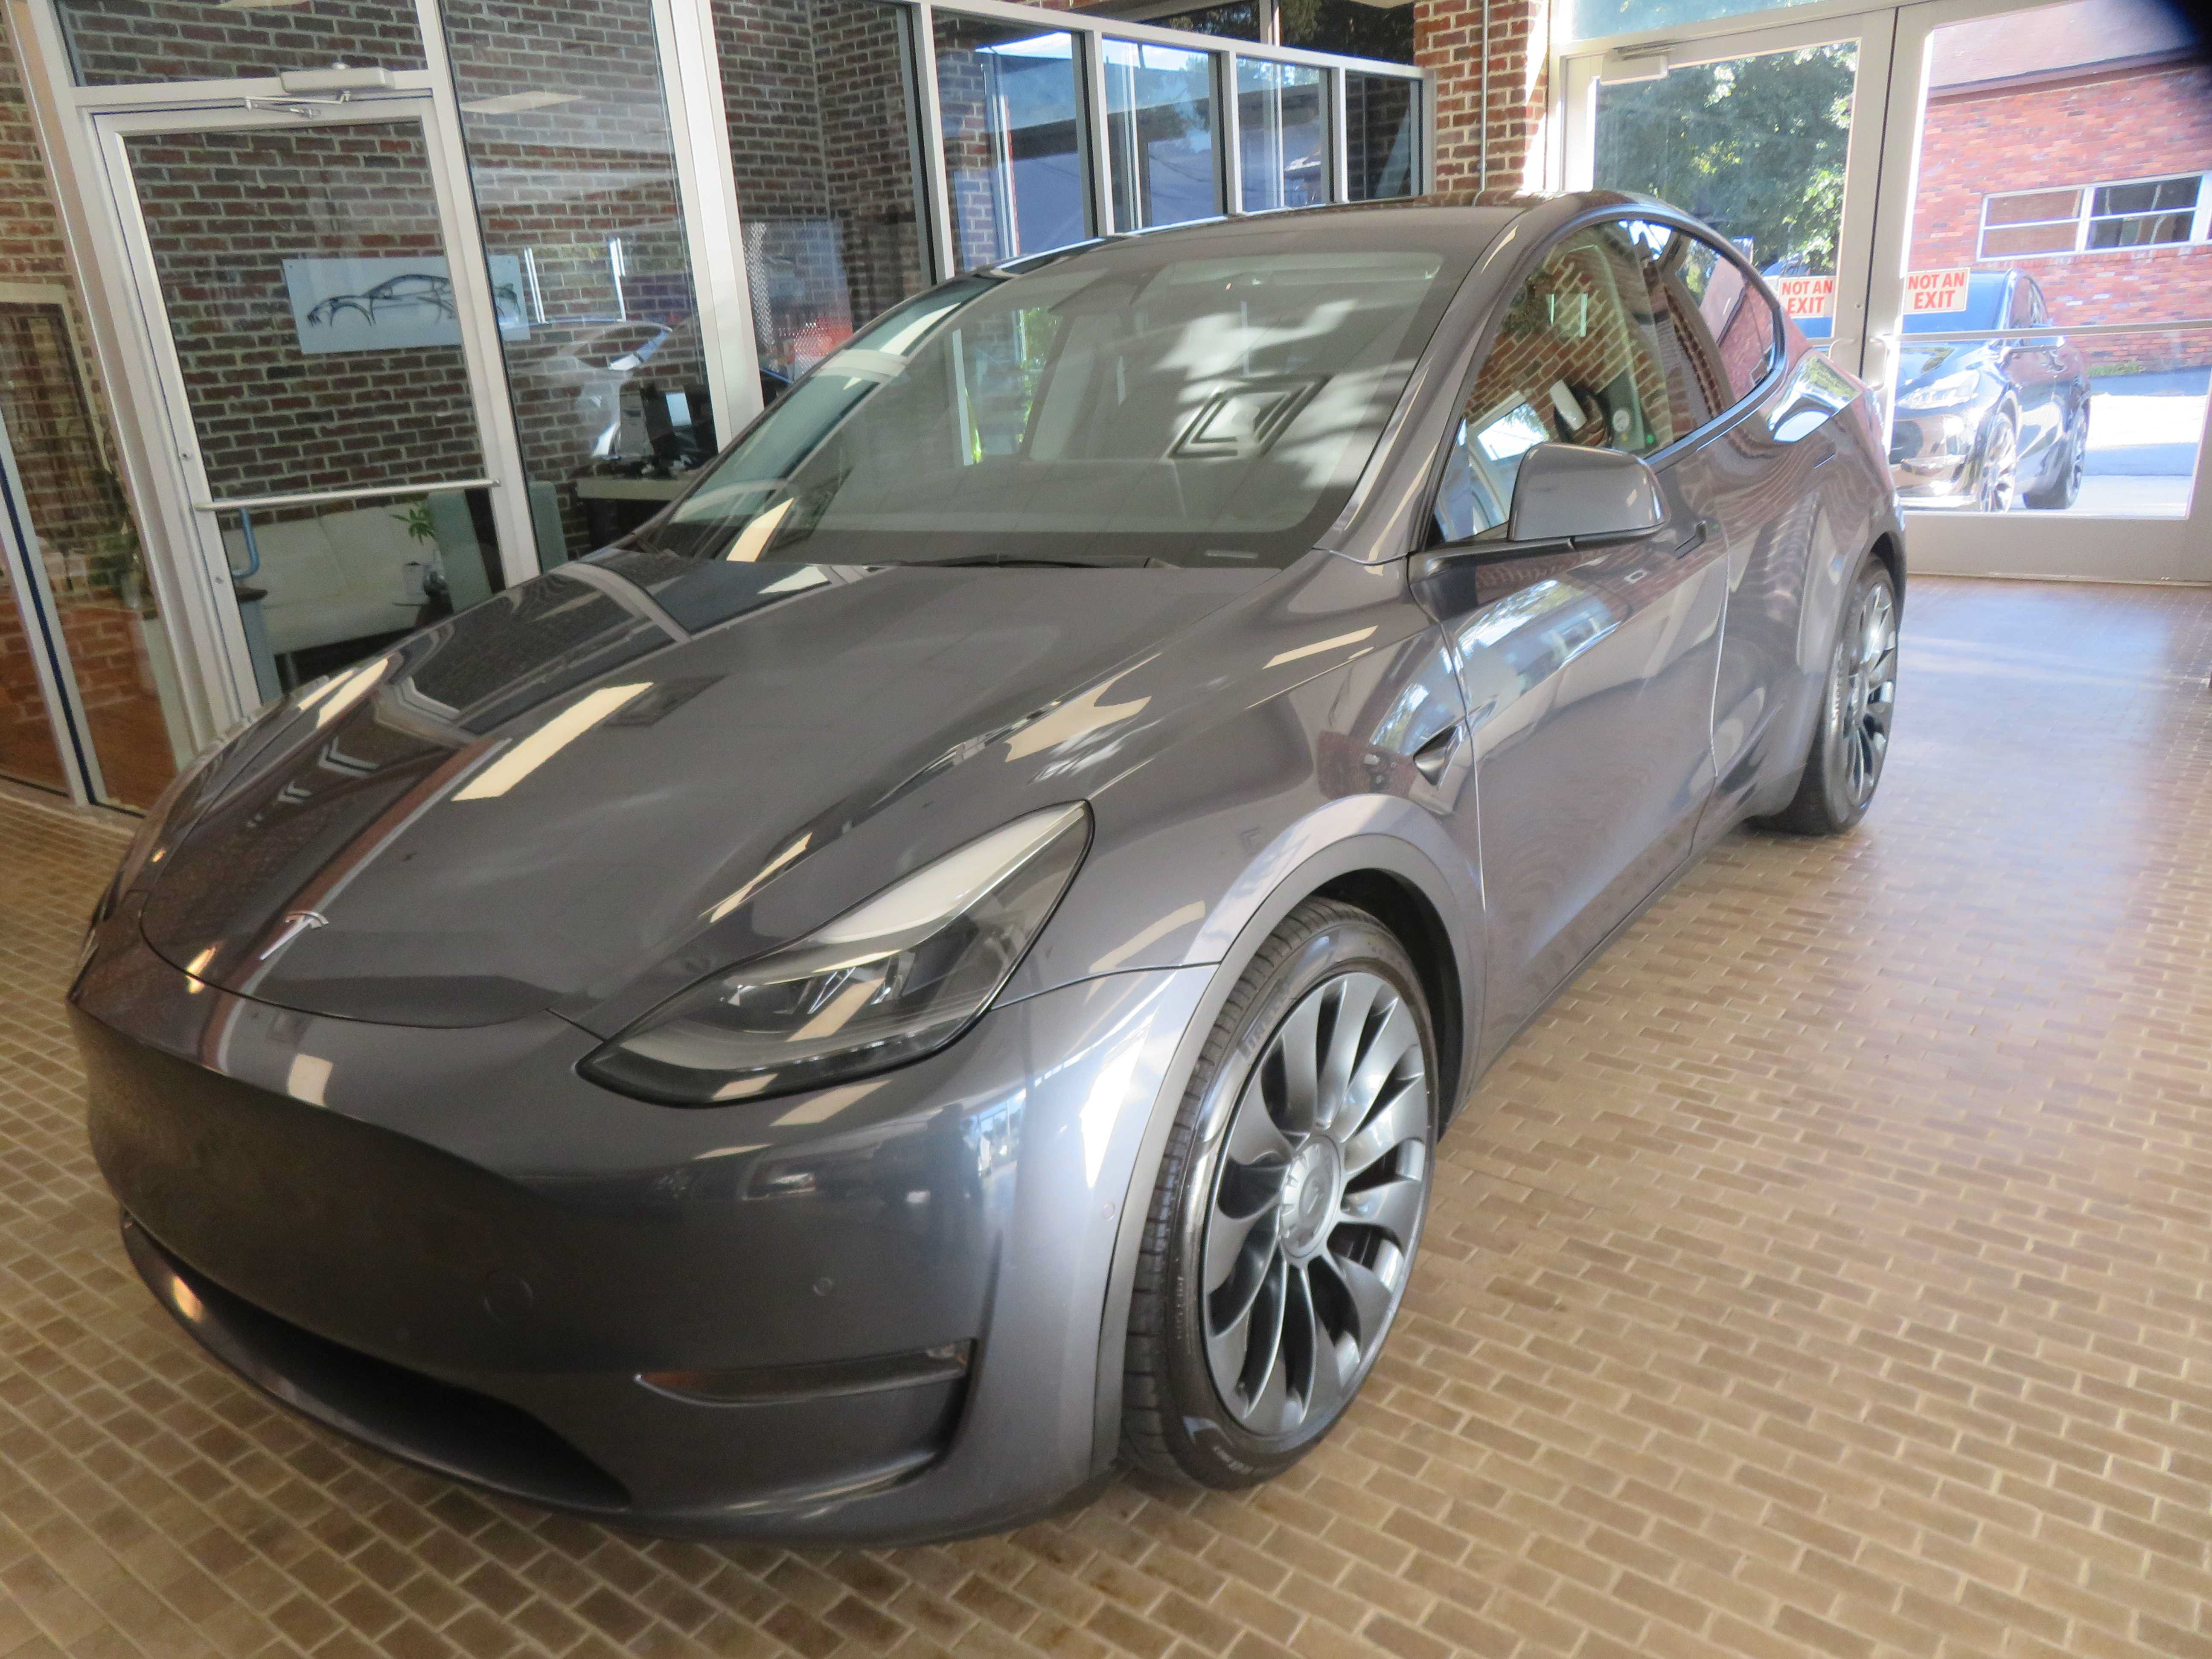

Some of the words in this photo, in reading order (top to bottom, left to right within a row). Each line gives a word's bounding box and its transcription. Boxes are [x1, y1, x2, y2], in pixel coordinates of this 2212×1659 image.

[1782, 281, 1810, 295] NOT
[1812, 279, 1833, 294] AN
[1908, 274, 1940, 290] NOT
[1942, 272, 1965, 288] AN
[1786, 296, 1825, 314] EXIT
[1914, 290, 1956, 309] EXIT
